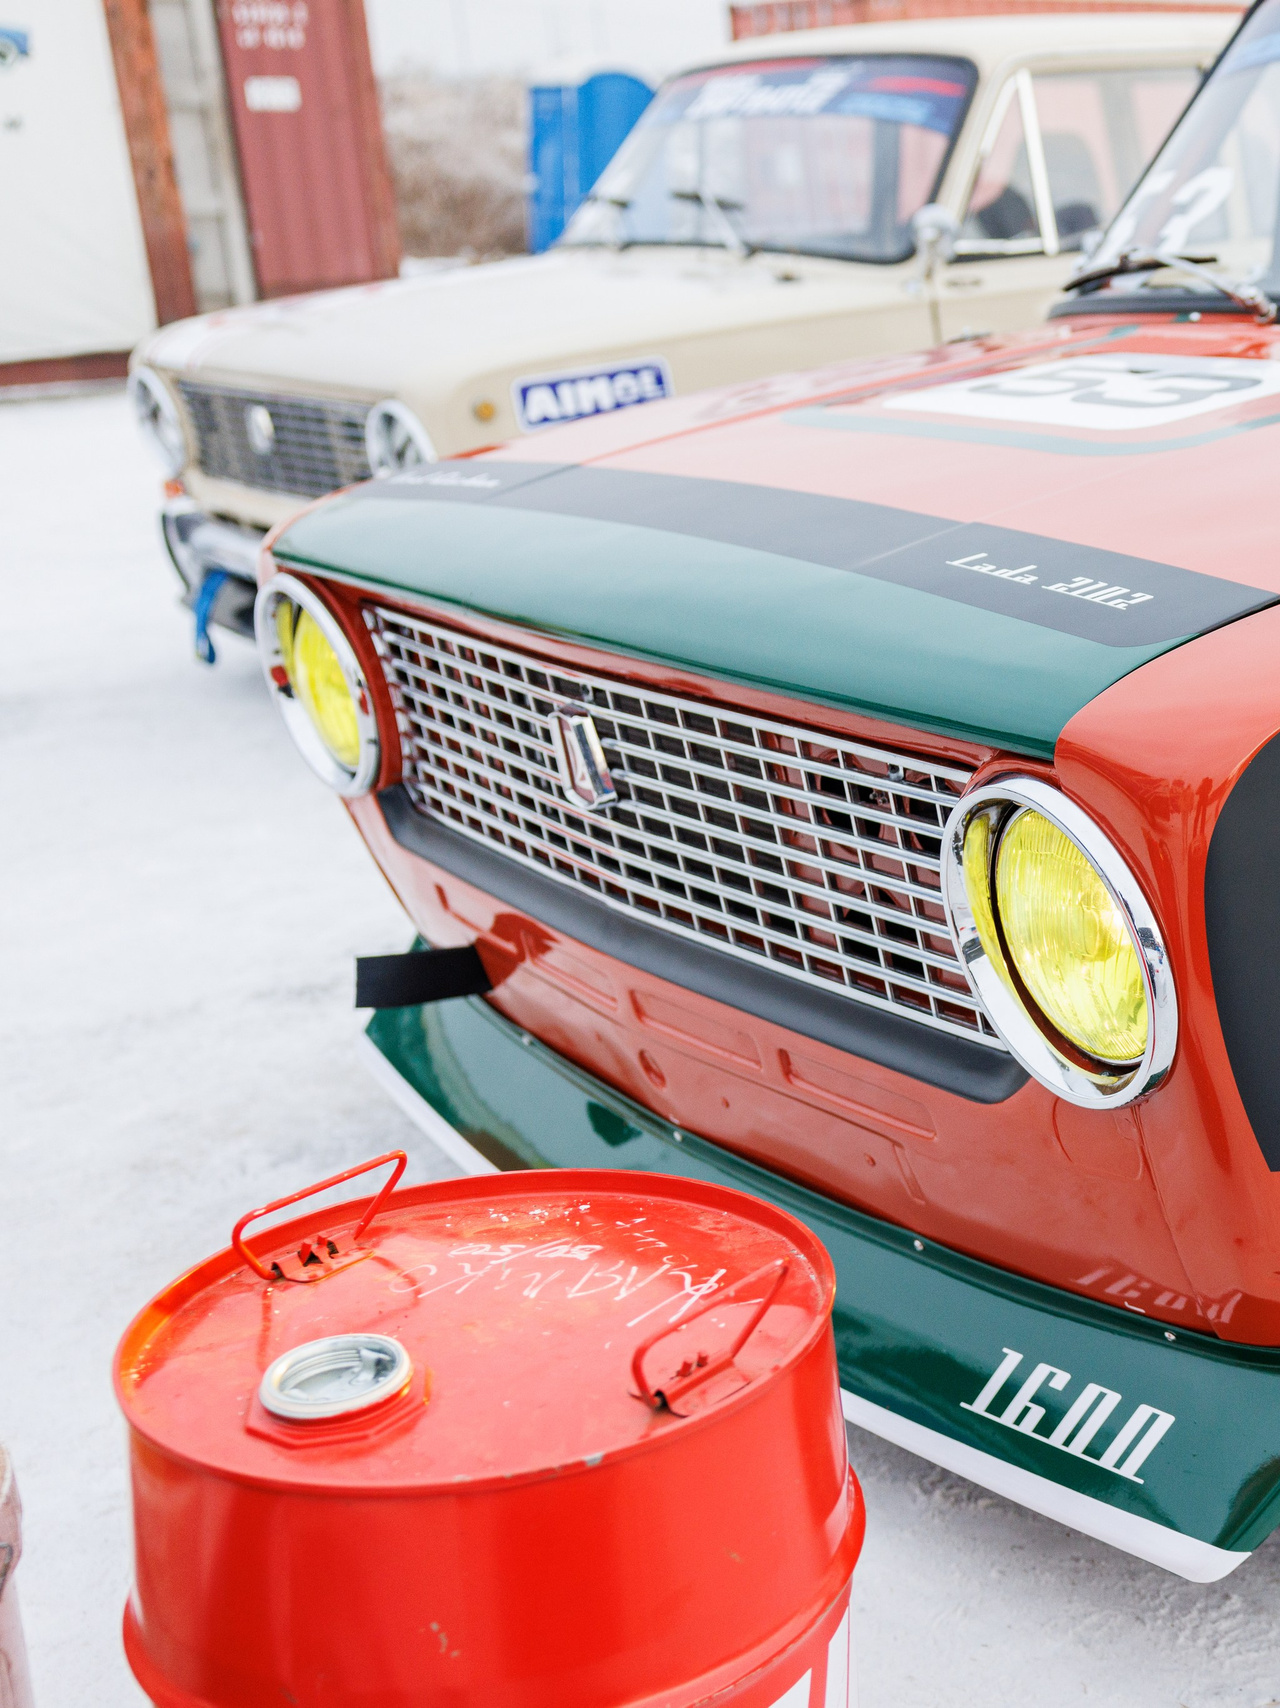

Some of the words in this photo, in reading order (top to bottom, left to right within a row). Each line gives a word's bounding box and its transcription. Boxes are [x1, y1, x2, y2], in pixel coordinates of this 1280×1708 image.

[526, 368, 665, 423] AIMOL
[946, 552, 1039, 585] Lada
[1041, 576, 1154, 611] 2102
[960, 1347, 1176, 1485] 1600
